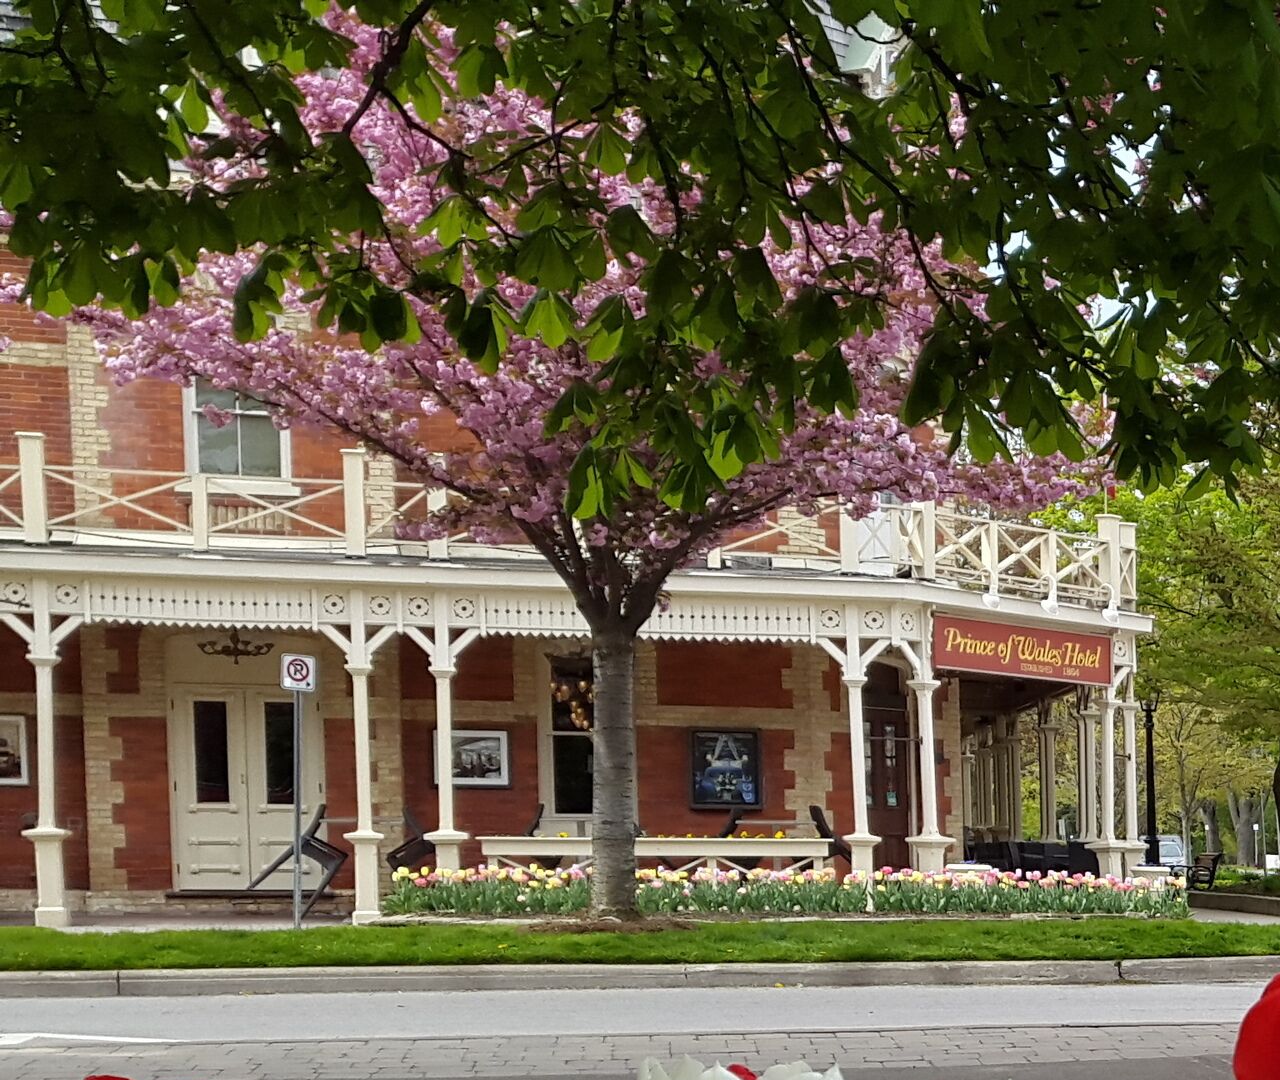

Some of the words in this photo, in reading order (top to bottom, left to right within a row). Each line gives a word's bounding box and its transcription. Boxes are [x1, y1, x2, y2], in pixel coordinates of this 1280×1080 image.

[944, 627, 995, 657] Prince
[997, 634, 1016, 664] of
[1014, 636, 1062, 668] Wales
[1062, 642, 1102, 669] Hotel
